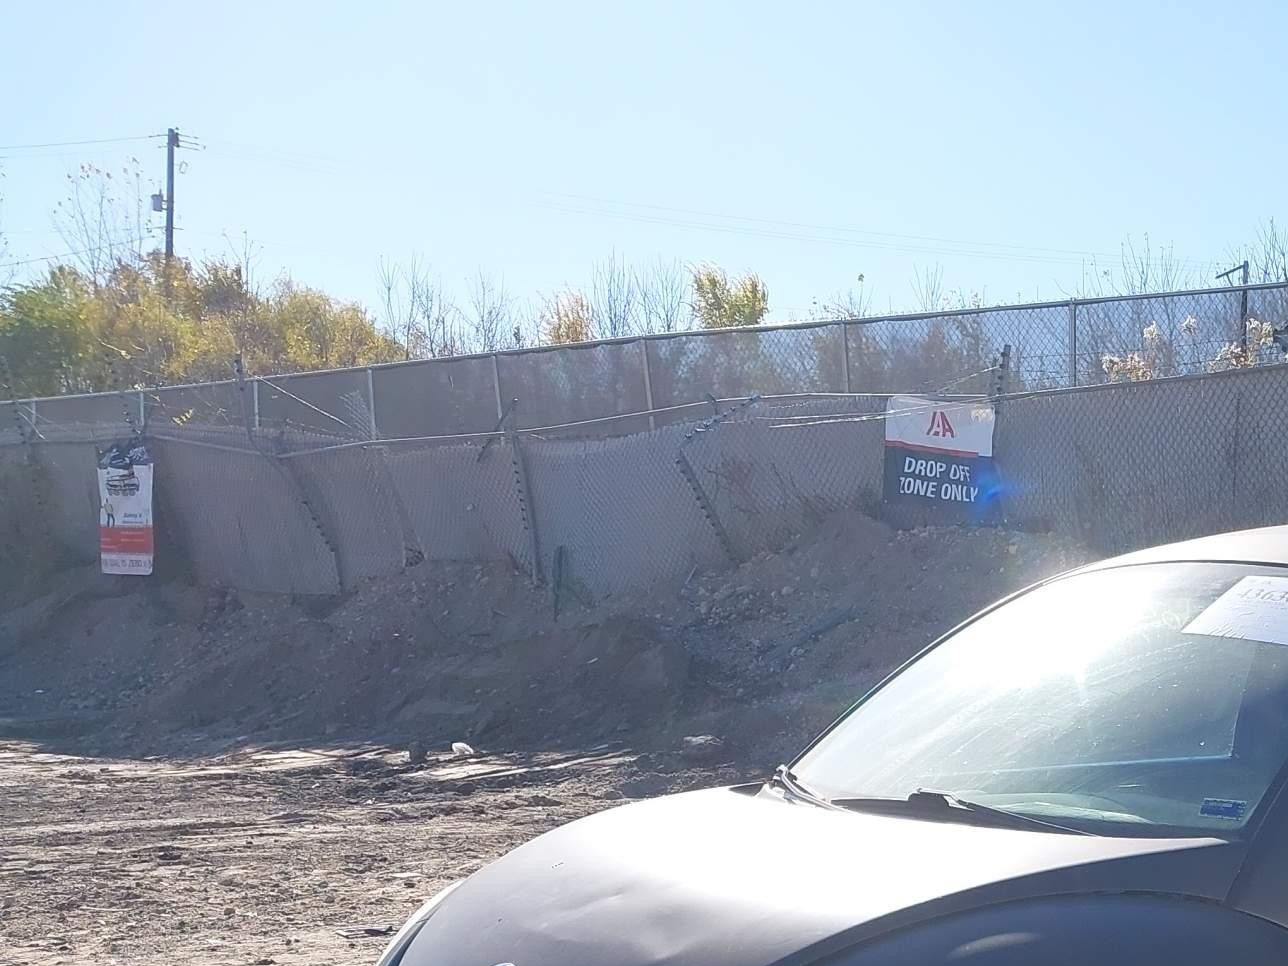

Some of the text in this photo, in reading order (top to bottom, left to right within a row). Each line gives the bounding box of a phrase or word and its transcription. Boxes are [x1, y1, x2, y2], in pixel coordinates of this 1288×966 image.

[904, 457, 971, 481] DROP OFF
[899, 477, 979, 502] ZONE ONLY
